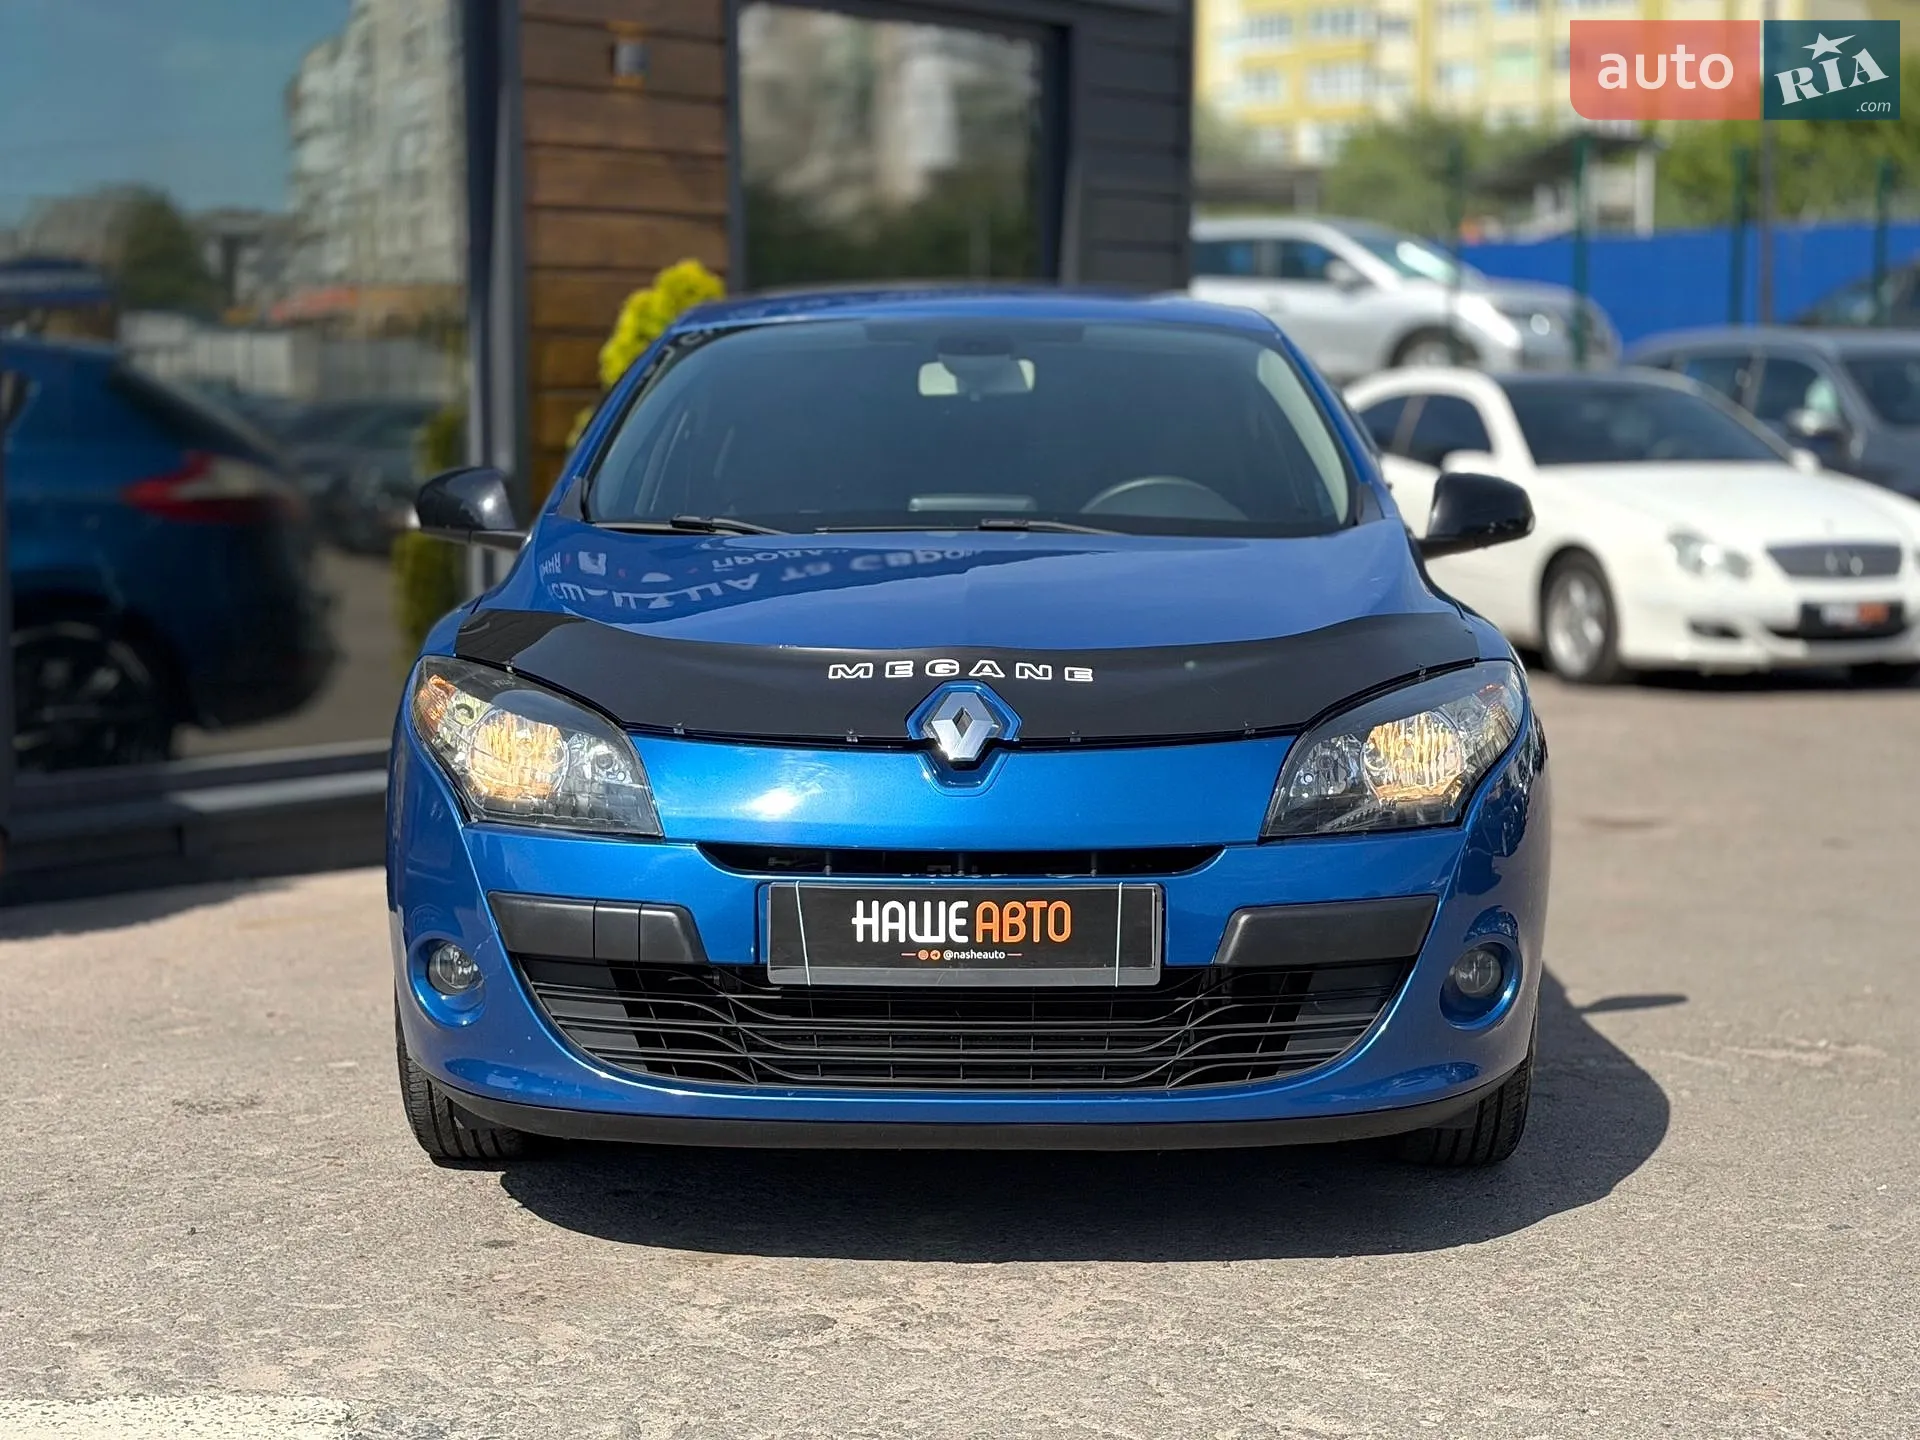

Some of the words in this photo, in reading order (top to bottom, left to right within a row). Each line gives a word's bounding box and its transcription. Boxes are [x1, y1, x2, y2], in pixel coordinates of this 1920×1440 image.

[828, 659, 1094, 682] MEGANE
[851, 900, 969, 943] НАШЕ
[975, 900, 1072, 943] АВТО
[943, 950, 1006, 961] @nasheauto
